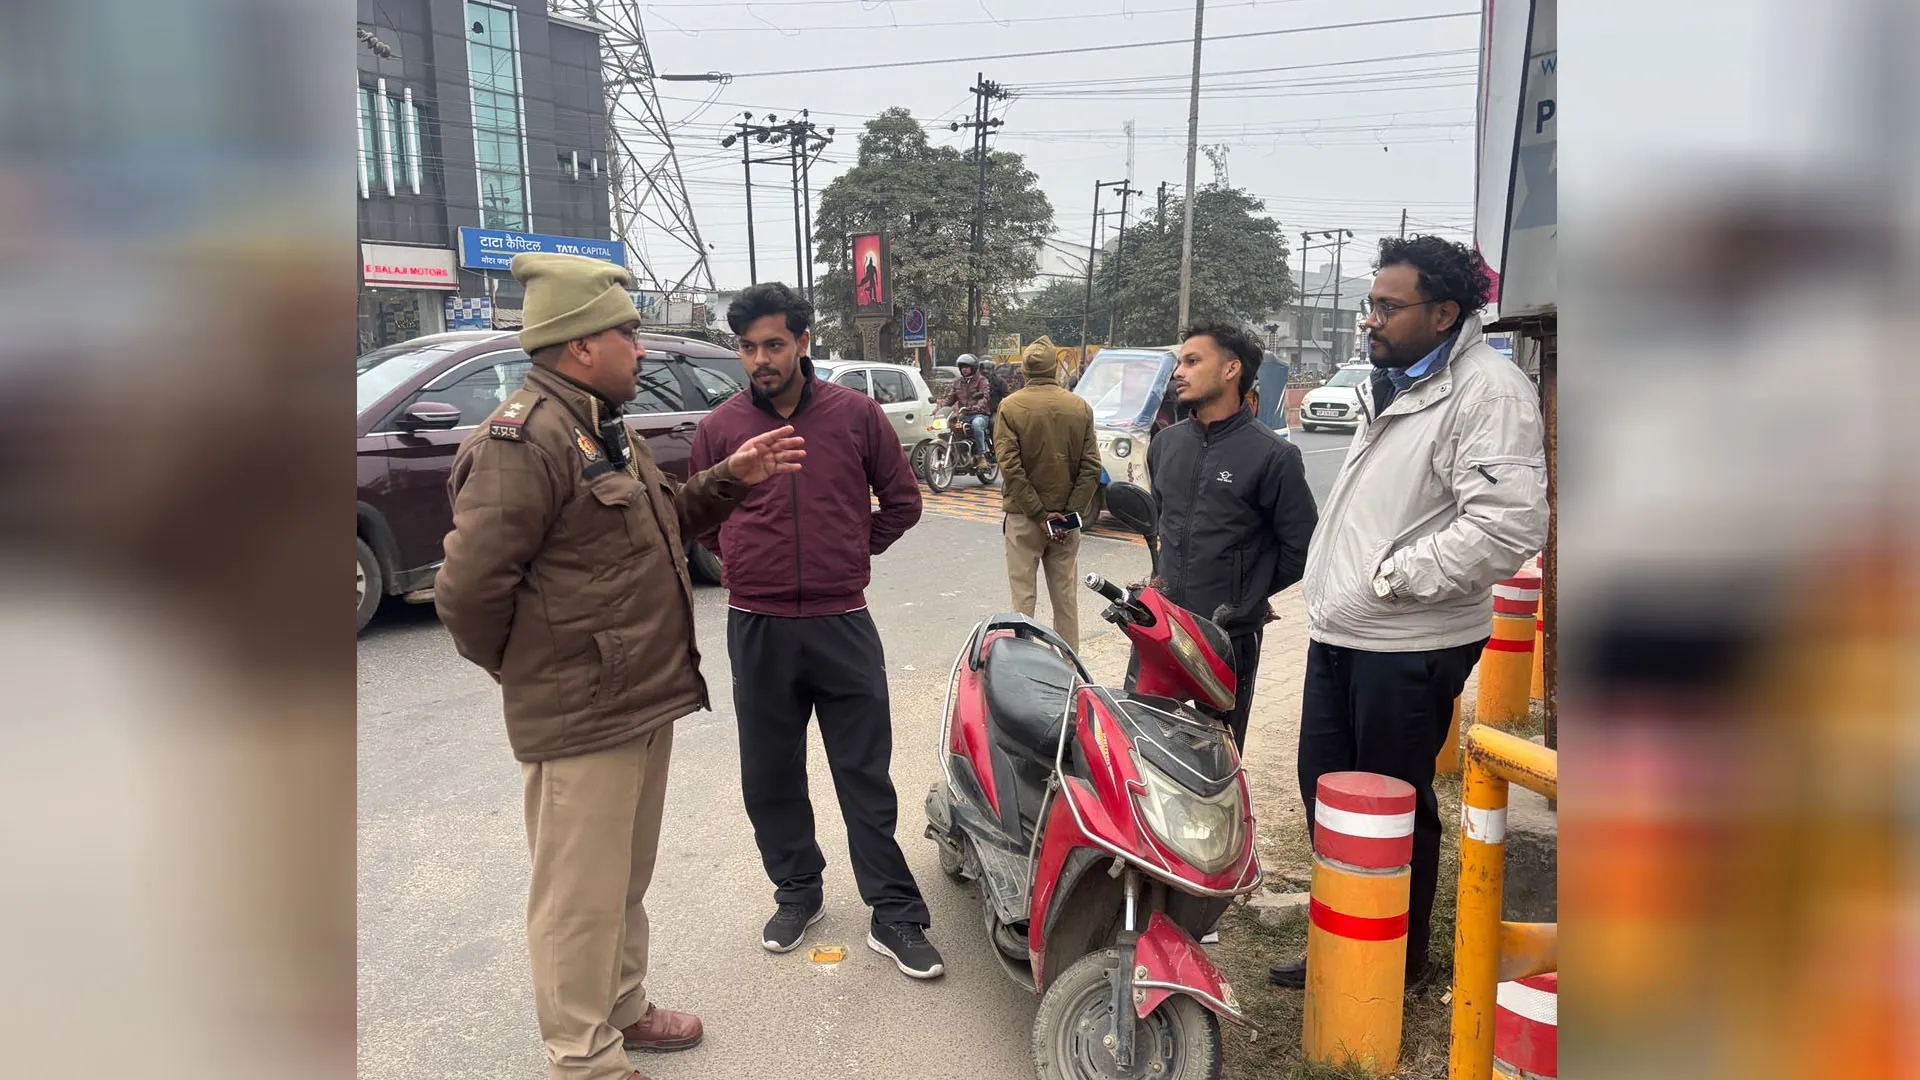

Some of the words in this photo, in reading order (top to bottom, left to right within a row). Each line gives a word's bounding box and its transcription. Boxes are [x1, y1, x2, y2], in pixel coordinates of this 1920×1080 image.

[479, 236, 503, 248] टाटा
[505, 234, 541, 251] कैपिटल
[555, 244, 579, 254] TATA
[581, 246, 611, 257] CAPITAL
[376, 265, 408, 275] BALAJI
[409, 267, 448, 277] MOTORS
